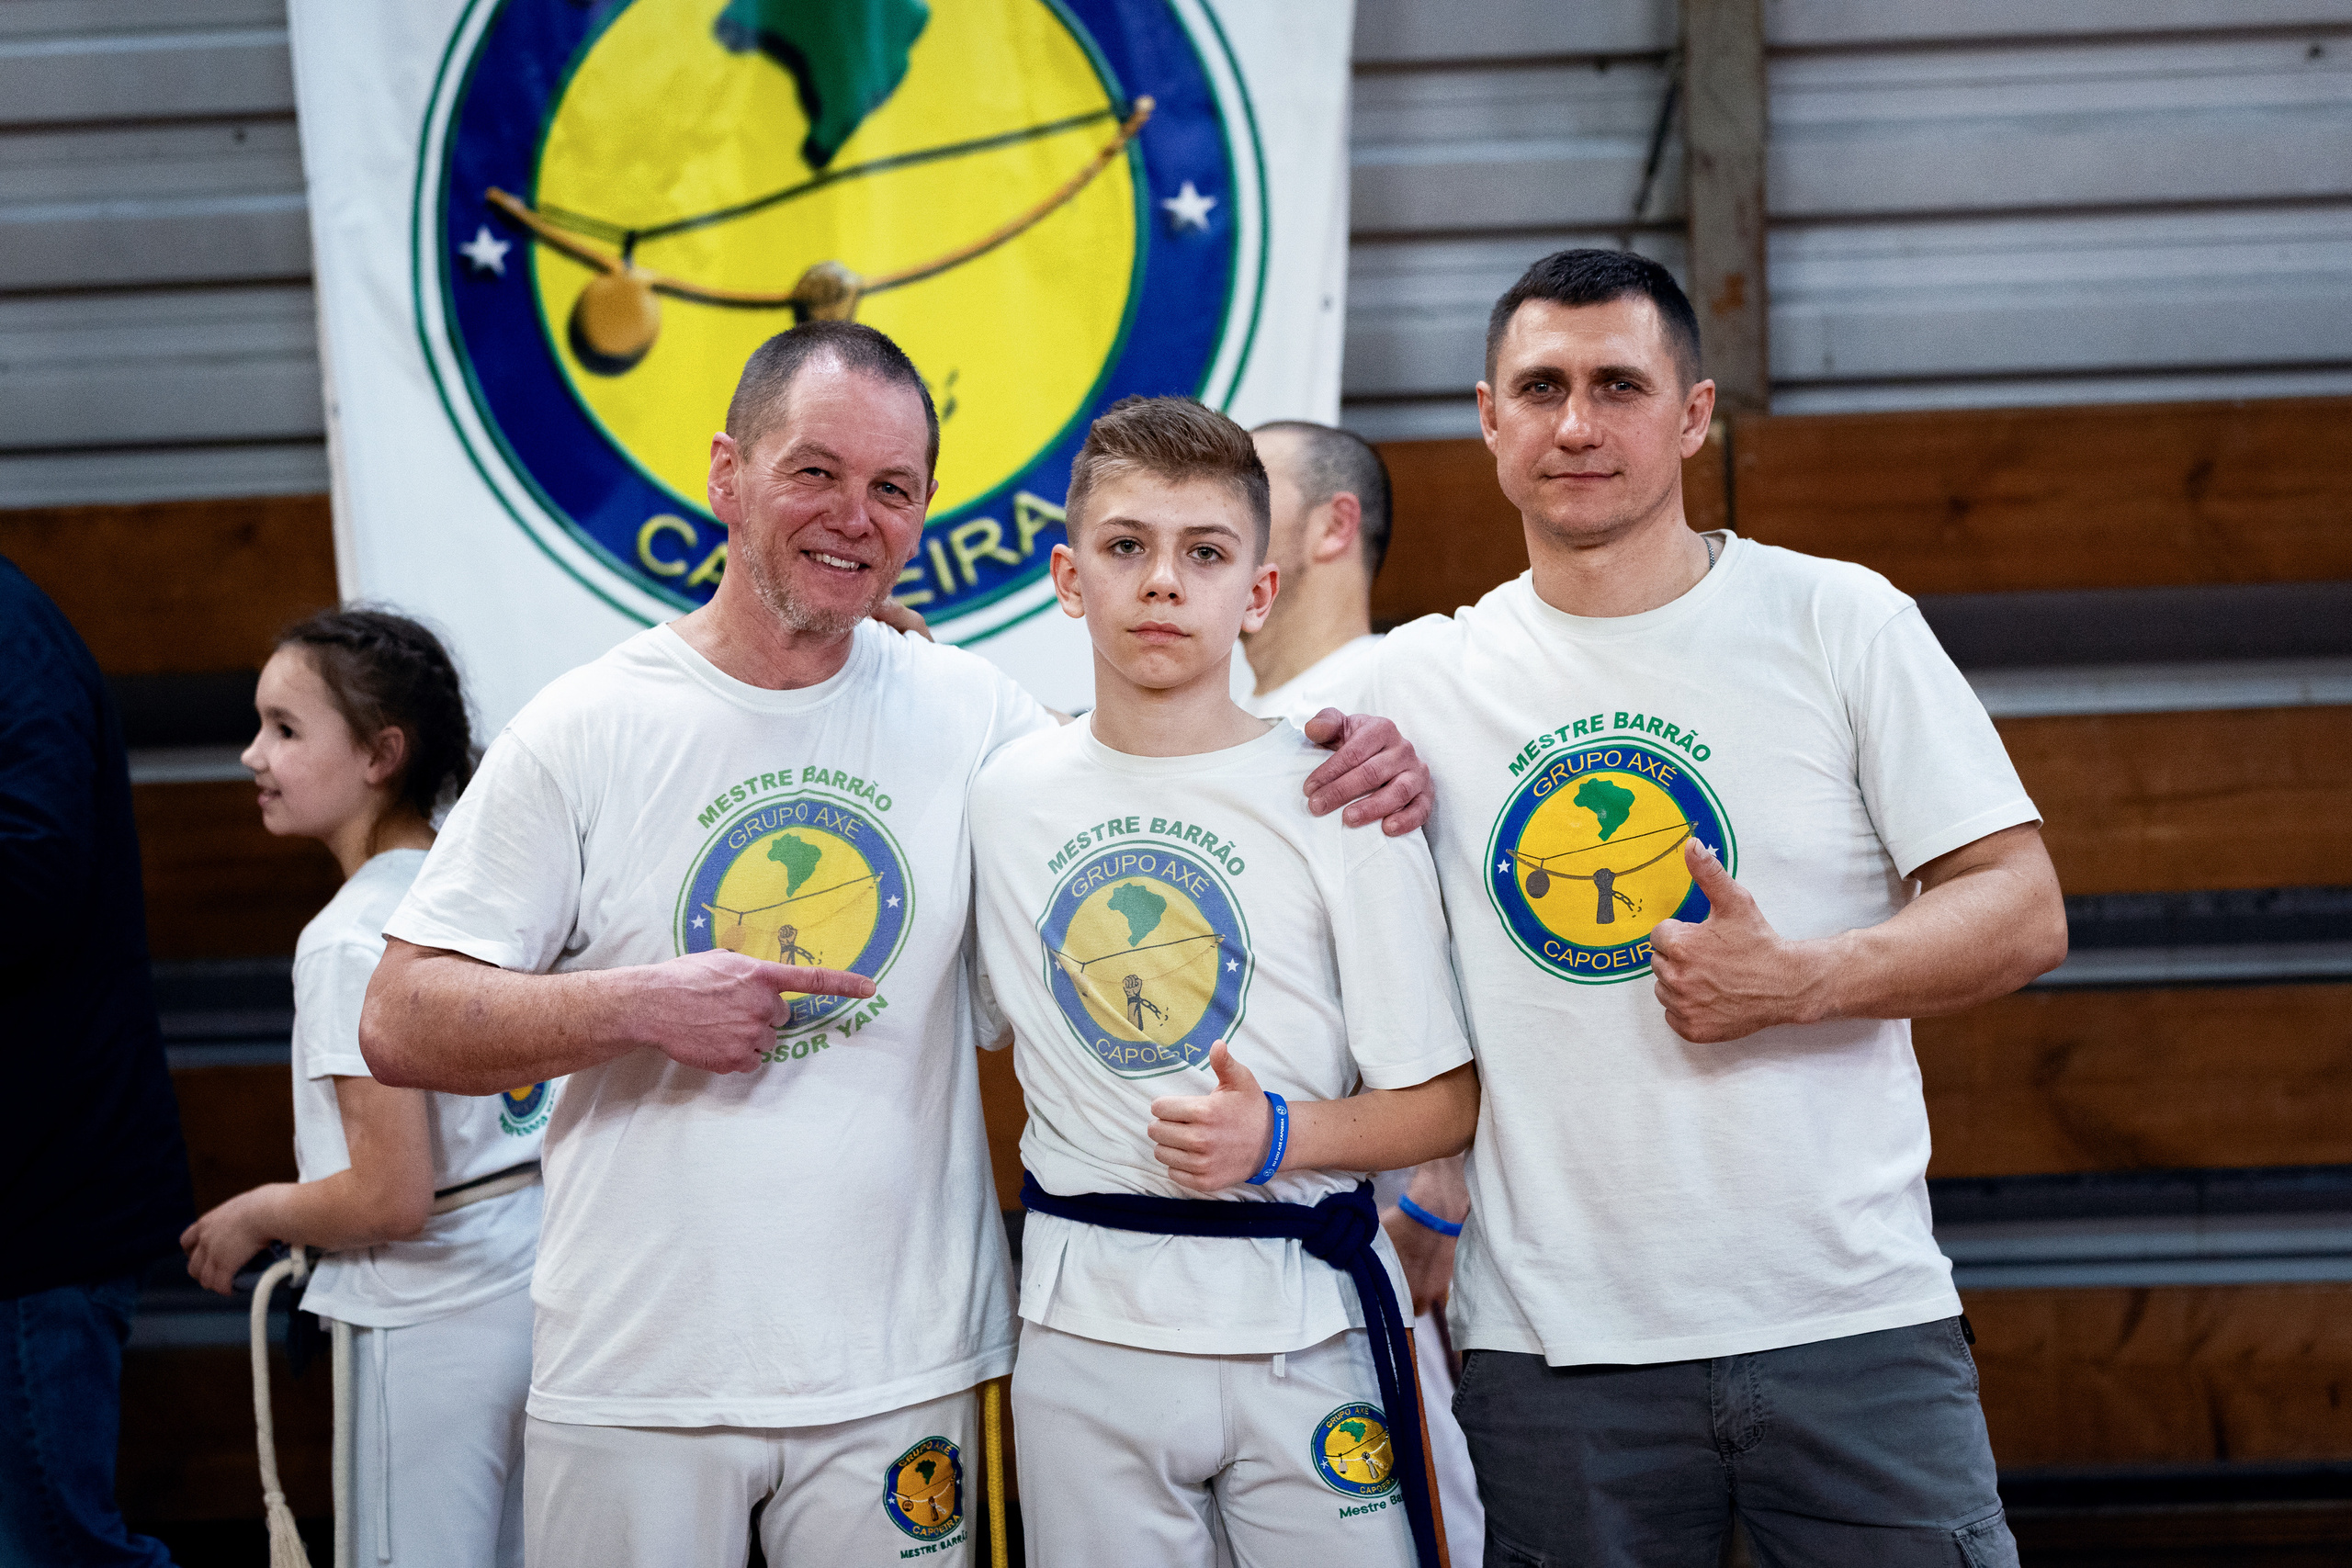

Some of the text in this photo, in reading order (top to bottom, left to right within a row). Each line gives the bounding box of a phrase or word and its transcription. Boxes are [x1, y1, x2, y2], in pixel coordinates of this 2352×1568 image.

[636, 490, 1067, 607] CAIRA
[1508, 711, 1712, 777] MESTRE BARRÃO
[1532, 750, 1678, 797] GRUPO AXÉ
[697, 765, 892, 829] MESTRE BARRÃO
[728, 803, 808, 850] GRUPO
[1047, 816, 1246, 876] MESTRE BARRÃO
[1071, 854, 1210, 898] GRUPO AXÉ
[1544, 940, 1655, 970] CAPOEIR
[835, 994, 889, 1039] YAN
[1096, 1038, 1202, 1064] CAPOEA
[1326, 1409, 1351, 1428] GRUPO
[898, 1440, 933, 1467] GRUPO
[912, 1514, 961, 1537] CAPOEIRA
[1339, 1501, 1387, 1518] Mestre
[900, 1544, 938, 1560] MESTRE
